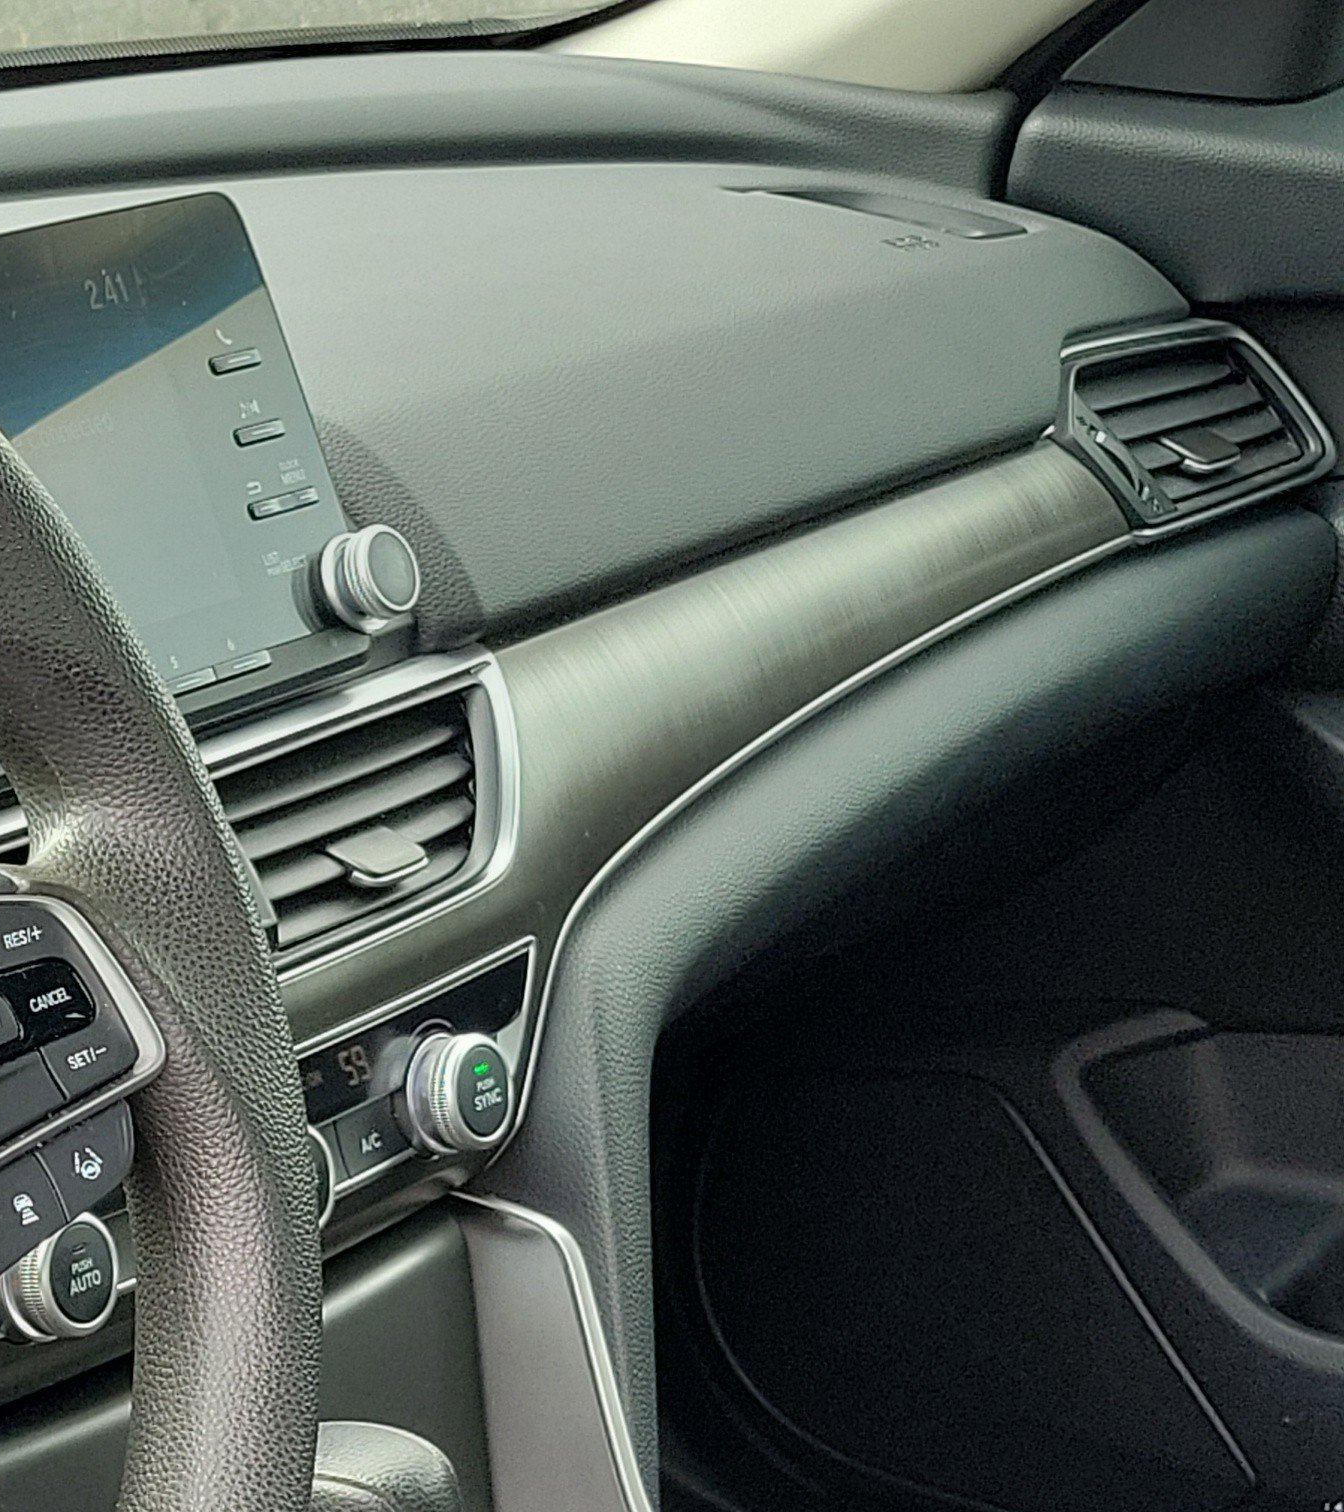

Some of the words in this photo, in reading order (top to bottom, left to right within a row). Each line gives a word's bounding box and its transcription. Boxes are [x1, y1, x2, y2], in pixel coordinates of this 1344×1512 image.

[29, 986, 73, 1013] CANCEL
[338, 1045, 372, 1086] 59
[474, 1088, 503, 1112] SYNC
[70, 1269, 102, 1298] AUTO
